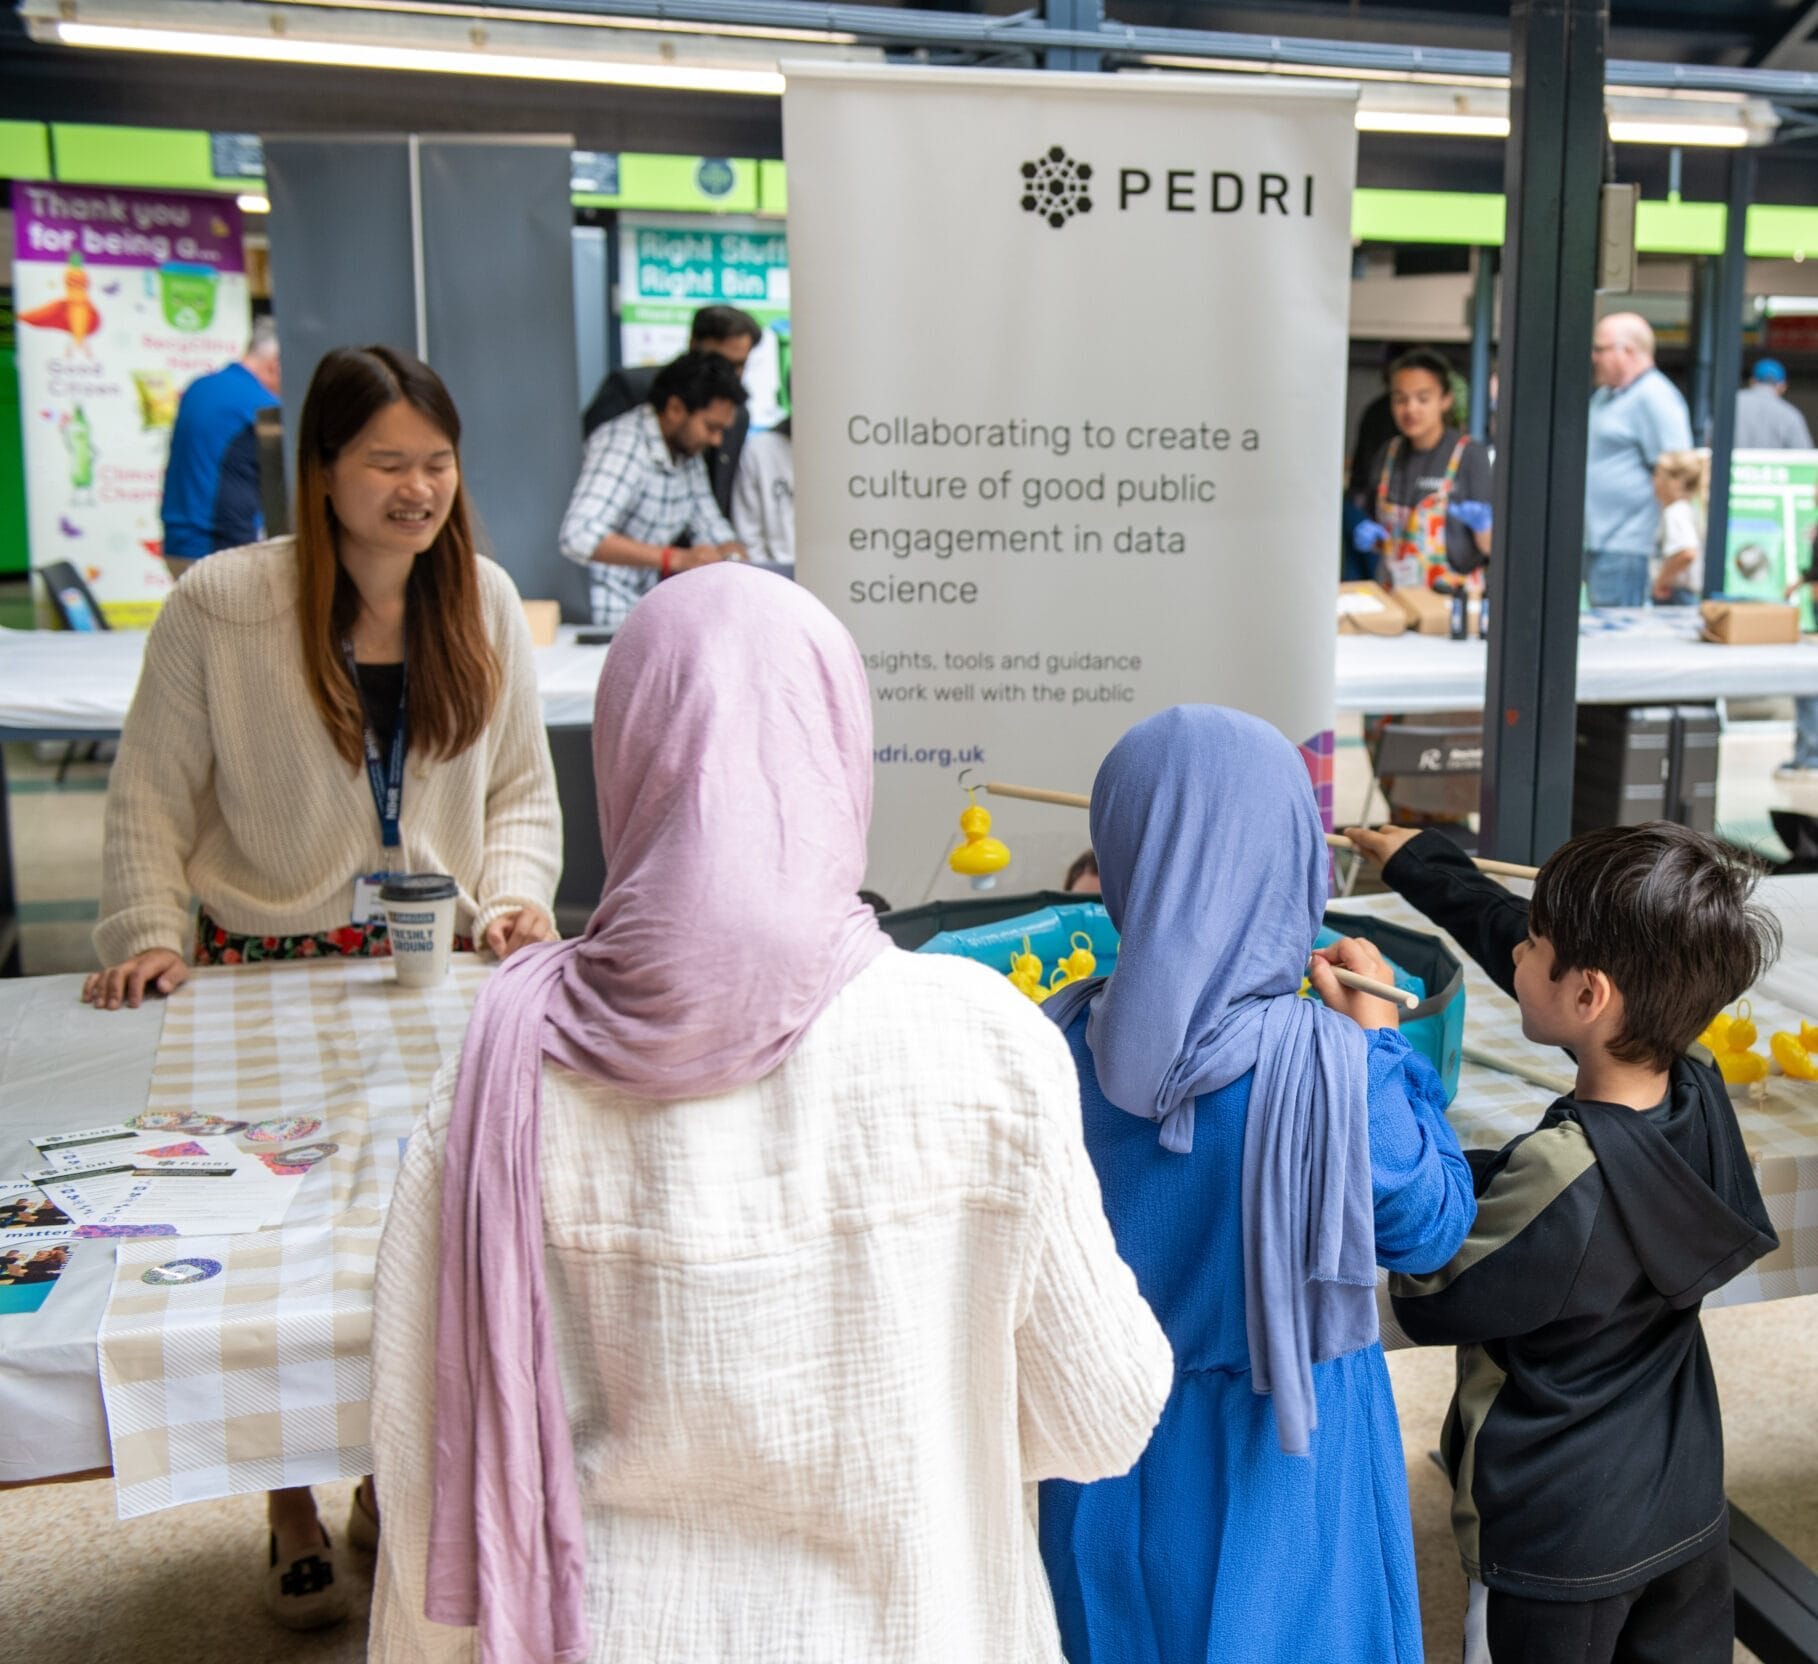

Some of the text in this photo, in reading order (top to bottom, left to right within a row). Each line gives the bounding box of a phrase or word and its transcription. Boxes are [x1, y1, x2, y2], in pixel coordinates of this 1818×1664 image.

[26, 187, 190, 230] Thank you
[1119, 168, 1314, 217] PEDRI
[28, 220, 76, 251] for
[81, 224, 170, 263] being
[640, 231, 713, 267] Right
[641, 264, 765, 297] Right Bin
[847, 414, 1260, 457] Collaborating to create a
[848, 469, 1216, 508] culture of good public
[848, 524, 1186, 560] engagement in data
[848, 574, 979, 605] science
[861, 651, 1142, 674] nsights, tools and guidance
[876, 683, 1134, 704] work well with the public
[873, 744, 985, 768] dri.org.uk
[391, 928, 434, 940] FRESHLY
